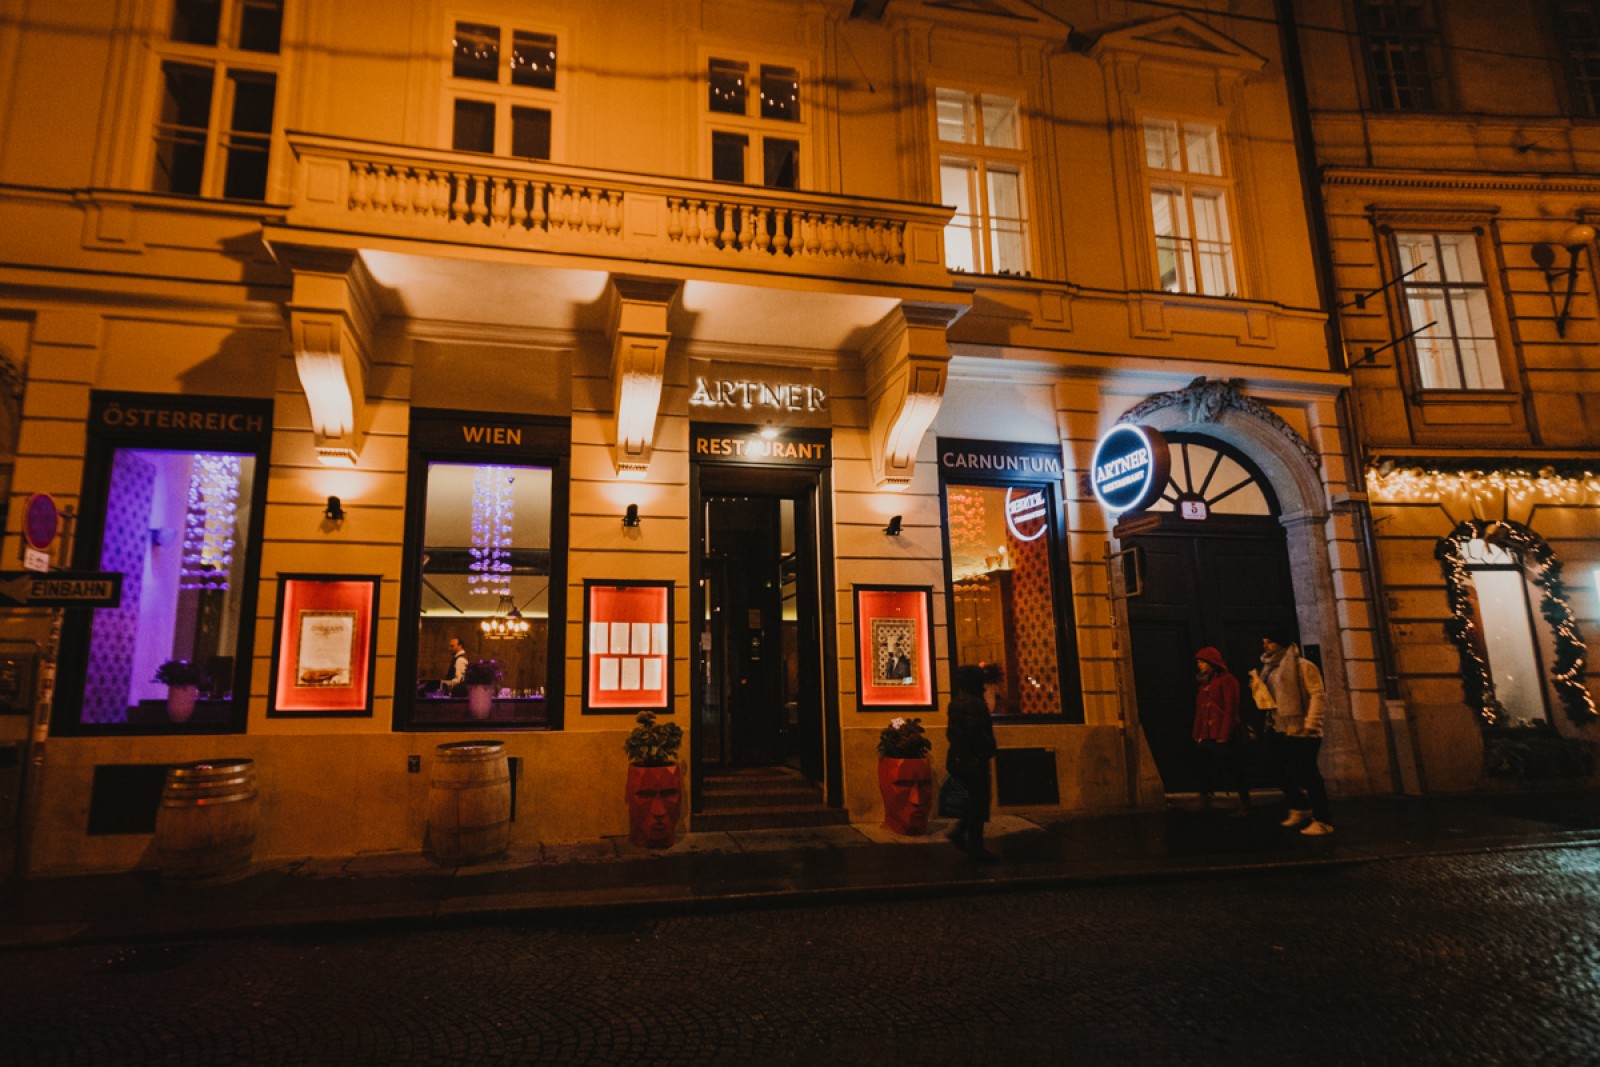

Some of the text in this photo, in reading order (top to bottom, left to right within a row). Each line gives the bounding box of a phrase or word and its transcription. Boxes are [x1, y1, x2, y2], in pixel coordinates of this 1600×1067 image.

[689, 376, 827, 412] ARTNER
[102, 403, 263, 432] ÖSTERREICH
[462, 426, 522, 445] WIEN
[696, 438, 825, 459] RESTAURANT
[943, 452, 1059, 472] CARNUNTUM
[1097, 448, 1148, 483] ARTNER
[32, 581, 106, 597] EINBAHN
